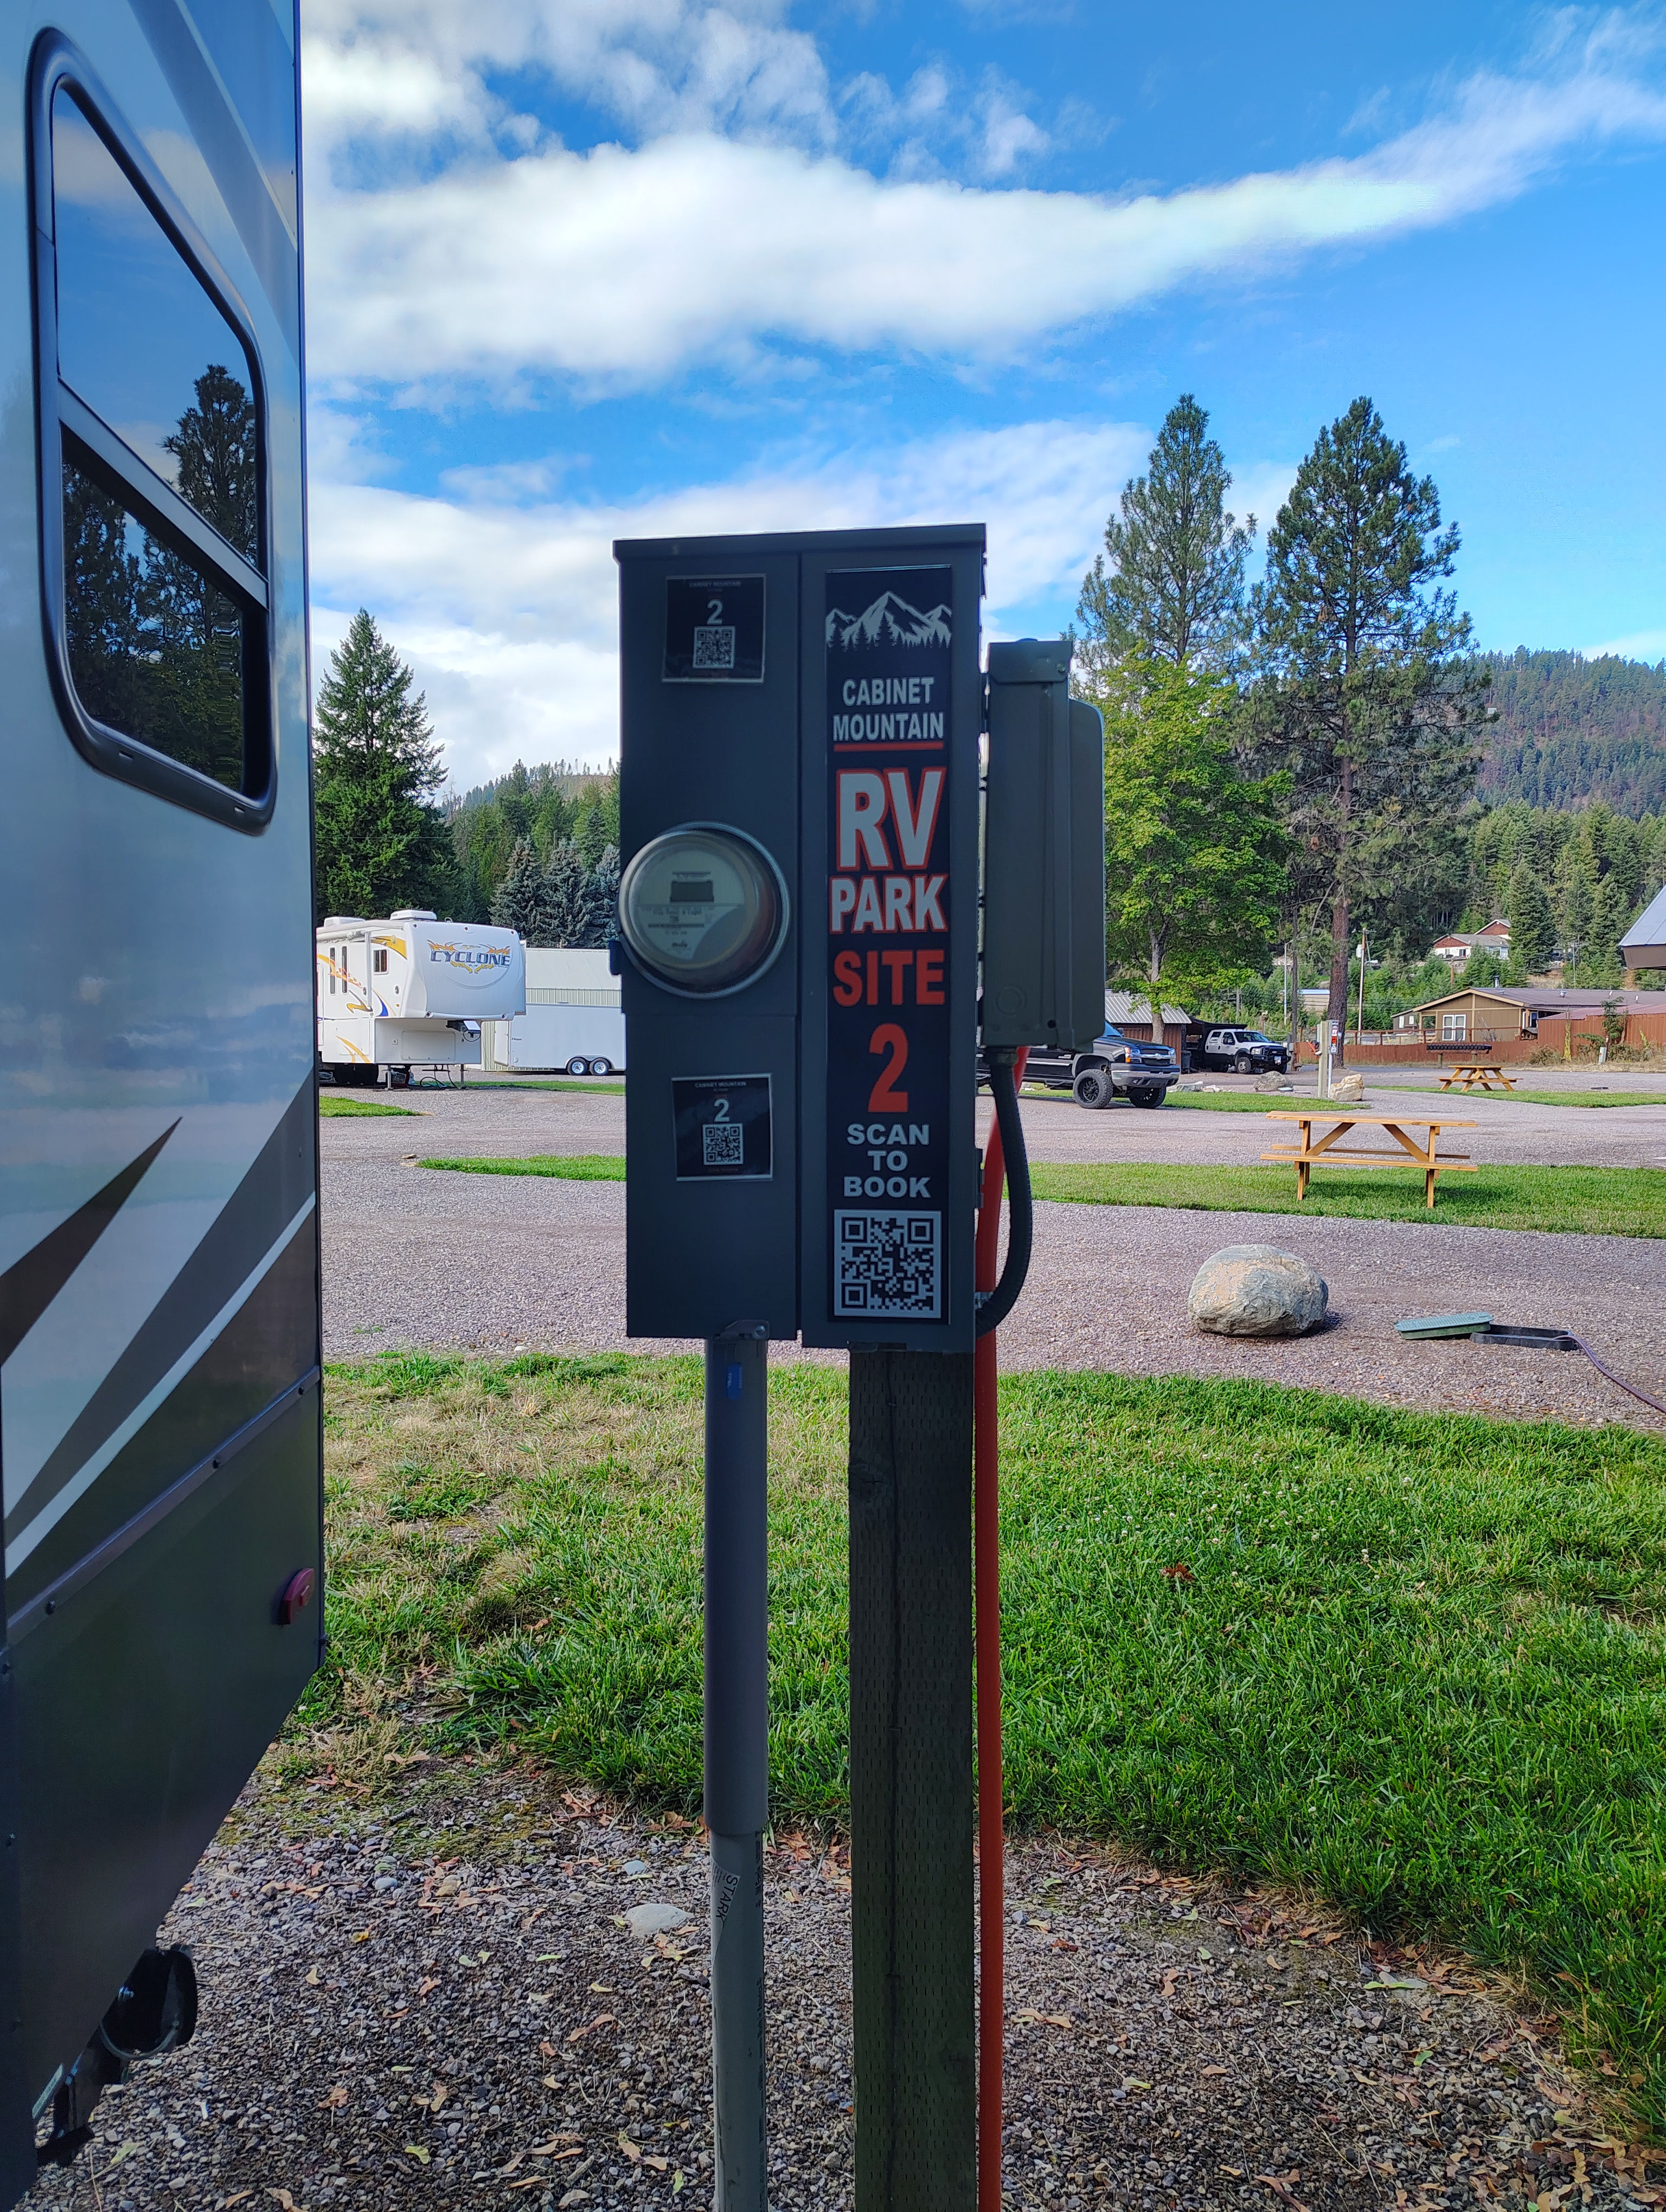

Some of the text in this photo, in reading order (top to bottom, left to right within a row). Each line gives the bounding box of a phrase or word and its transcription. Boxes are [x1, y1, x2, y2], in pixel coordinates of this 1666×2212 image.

[707, 600, 723, 625] 2
[842, 677, 934, 706] CABINET
[833, 712, 944, 742] MOUNTAIN
[836, 767, 946, 871] RV
[829, 874, 948, 933] PARK
[431, 950, 511, 967] CYCLONE
[833, 949, 945, 1006] SITE
[868, 1023, 908, 1113] 2
[714, 1098, 730, 1122] 2
[847, 1123, 930, 1146] SCAN
[868, 1150, 908, 1172] TO
[843, 1176, 931, 1198] BOOK
[715, 1874, 738, 1921] STARK
